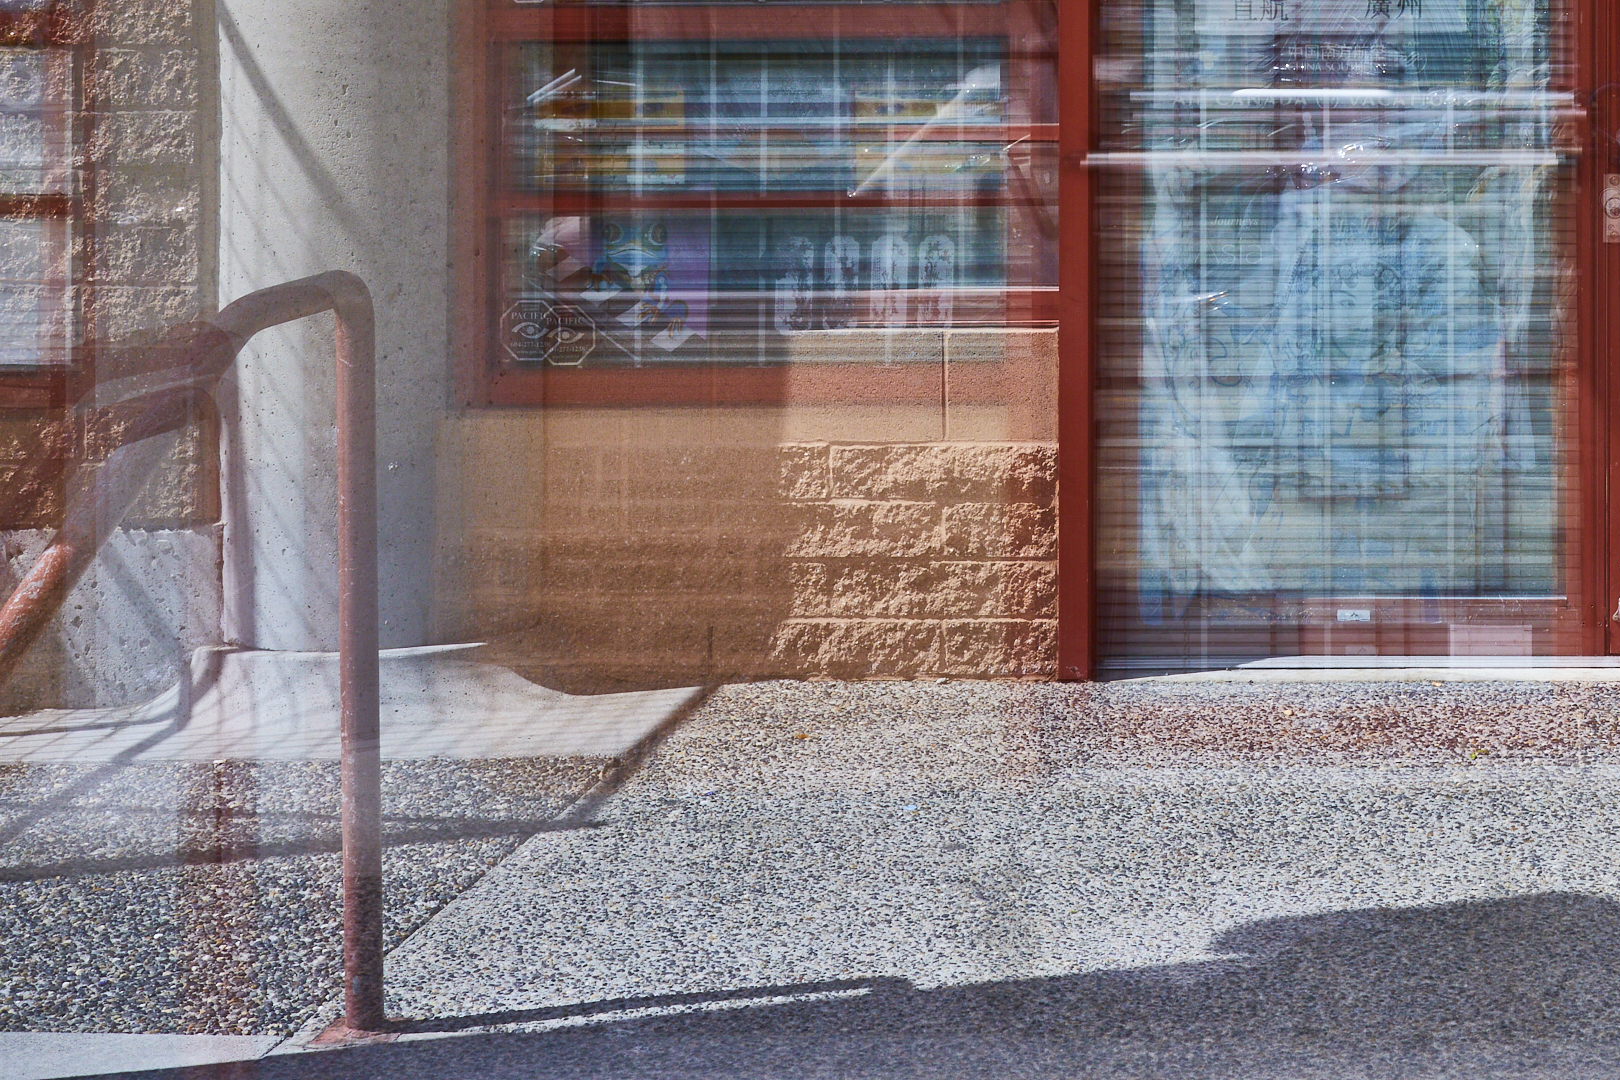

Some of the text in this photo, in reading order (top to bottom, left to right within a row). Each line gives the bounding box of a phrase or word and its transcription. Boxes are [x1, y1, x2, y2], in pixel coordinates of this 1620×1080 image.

[1210, 214, 1260, 227] Journeys
[1194, 241, 1264, 265] Asia
[546, 317, 585, 326] PACIFIC
